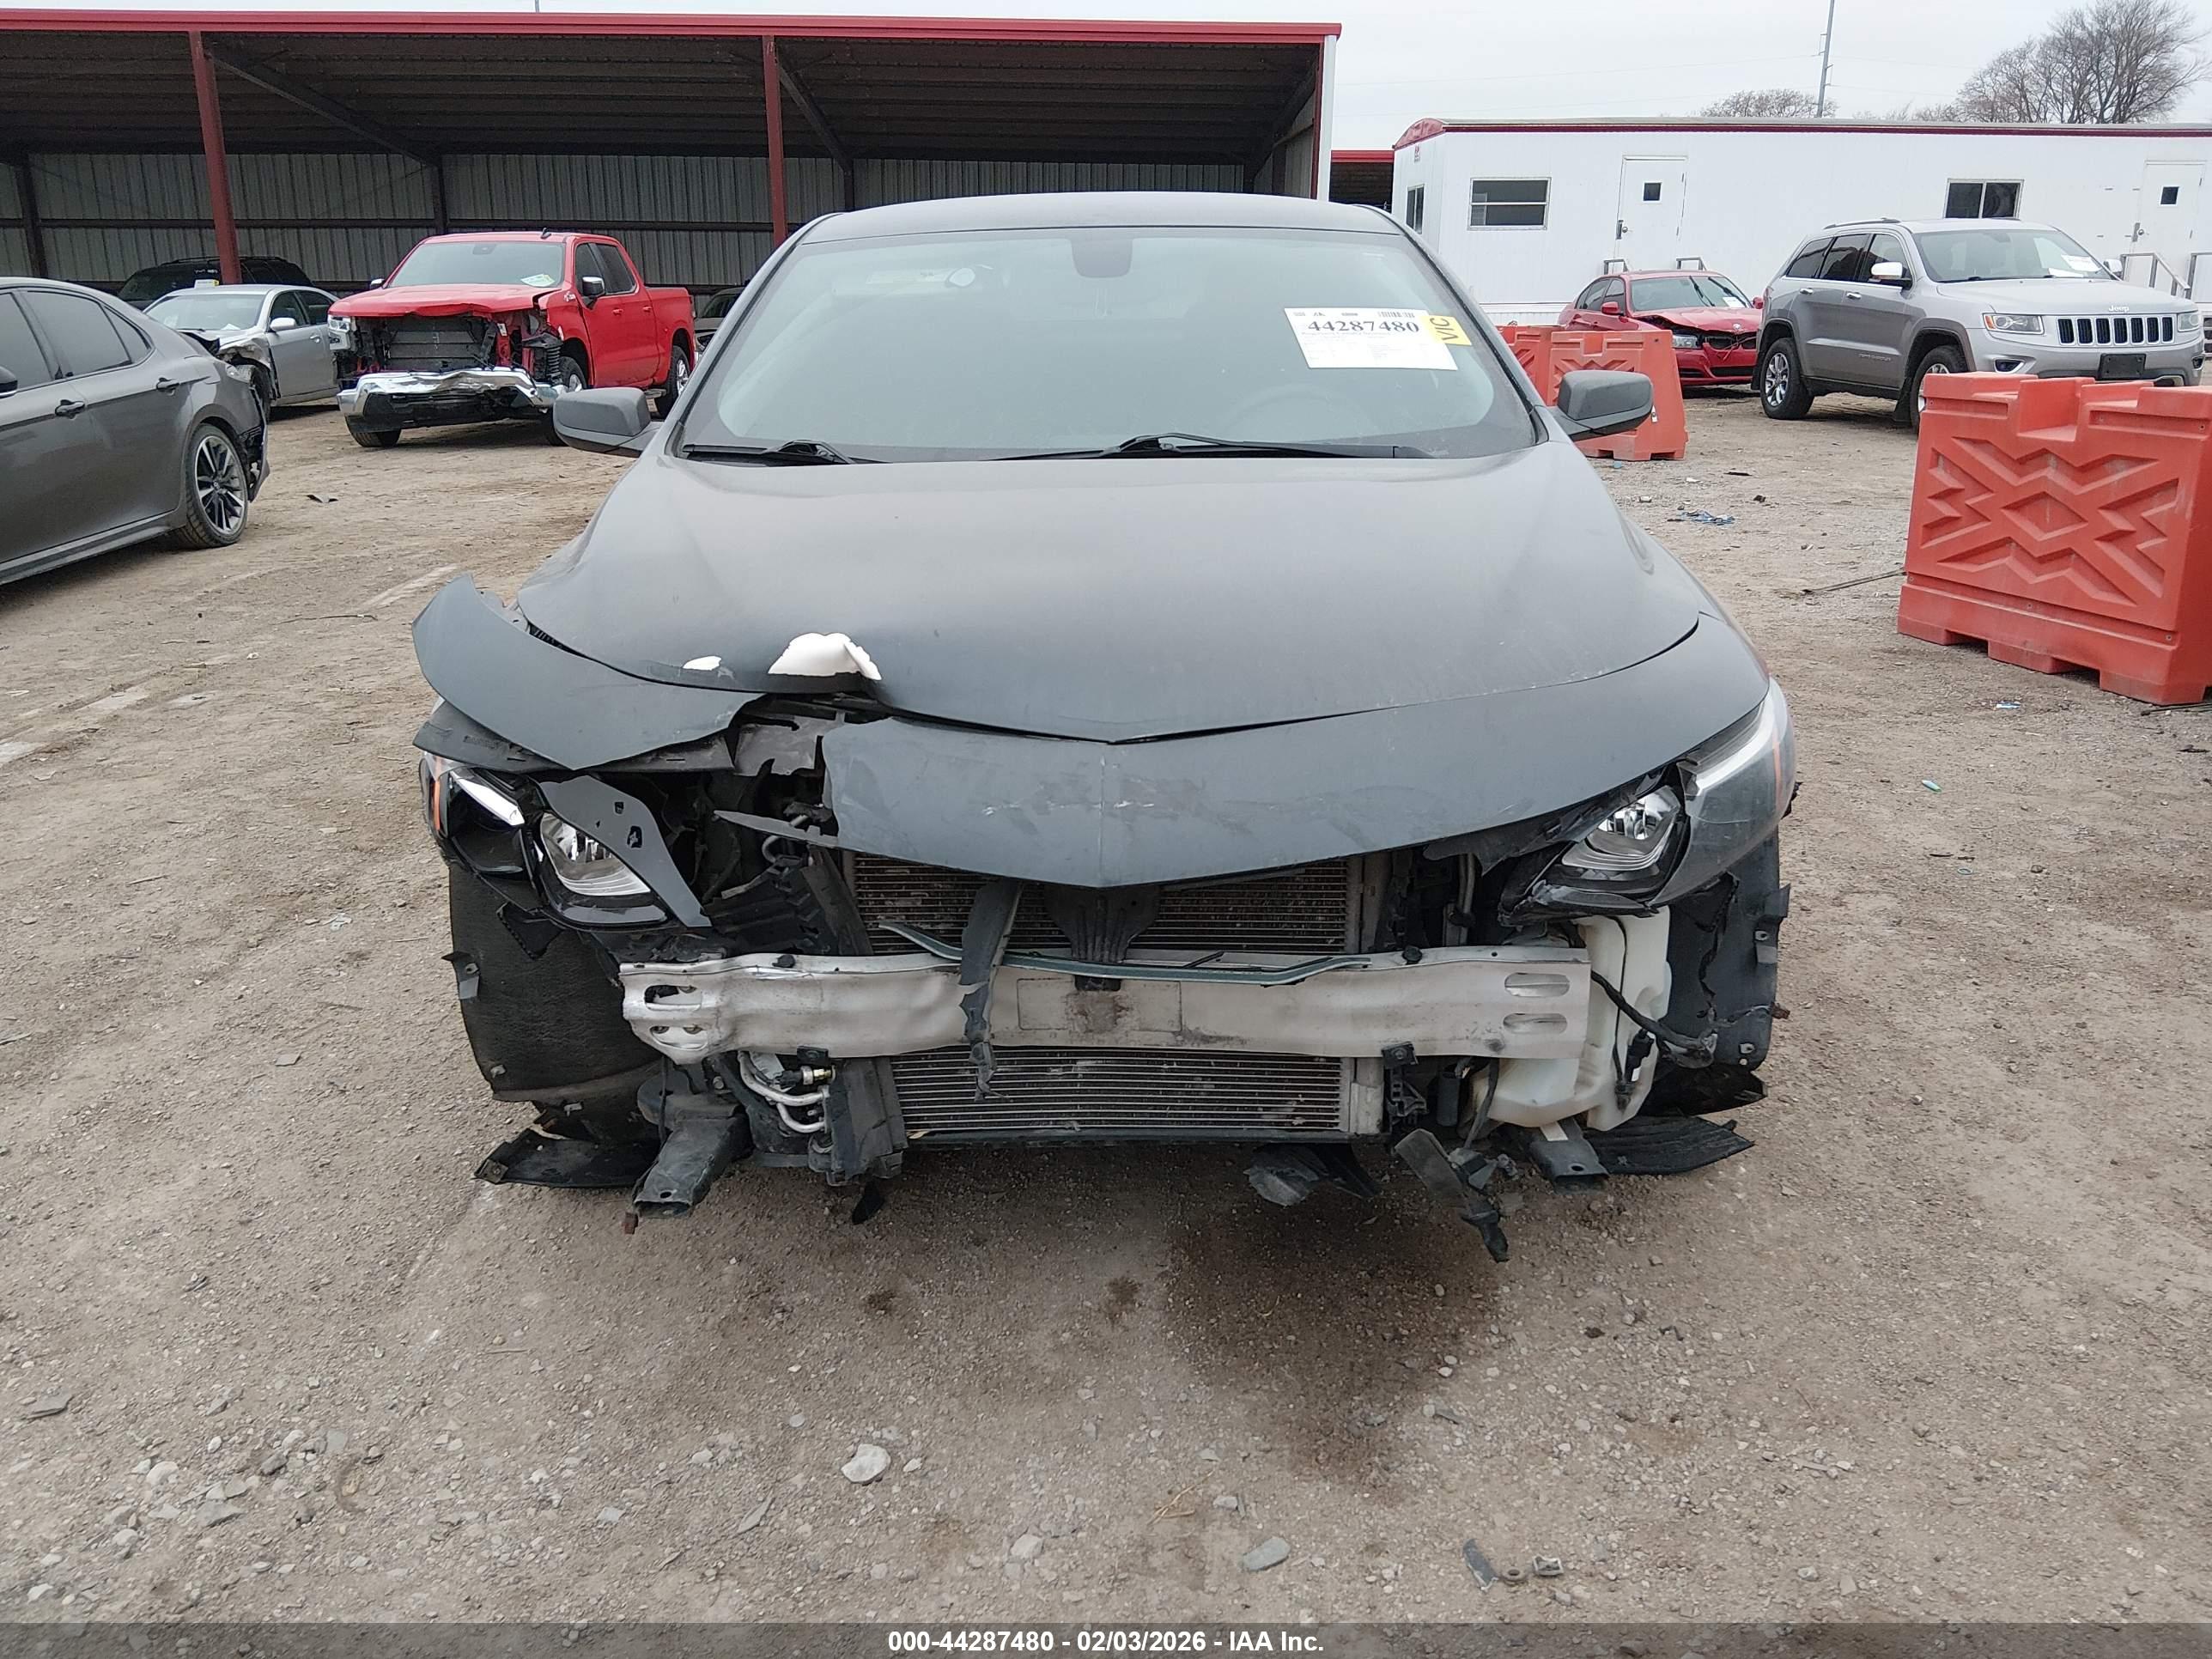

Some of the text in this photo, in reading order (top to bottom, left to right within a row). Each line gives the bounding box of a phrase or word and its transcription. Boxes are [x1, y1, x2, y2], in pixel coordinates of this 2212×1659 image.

[2108, 305, 2130, 313] Jeep
[1308, 320, 1420, 333] 44287480
[1429, 317, 1459, 341] VIC
